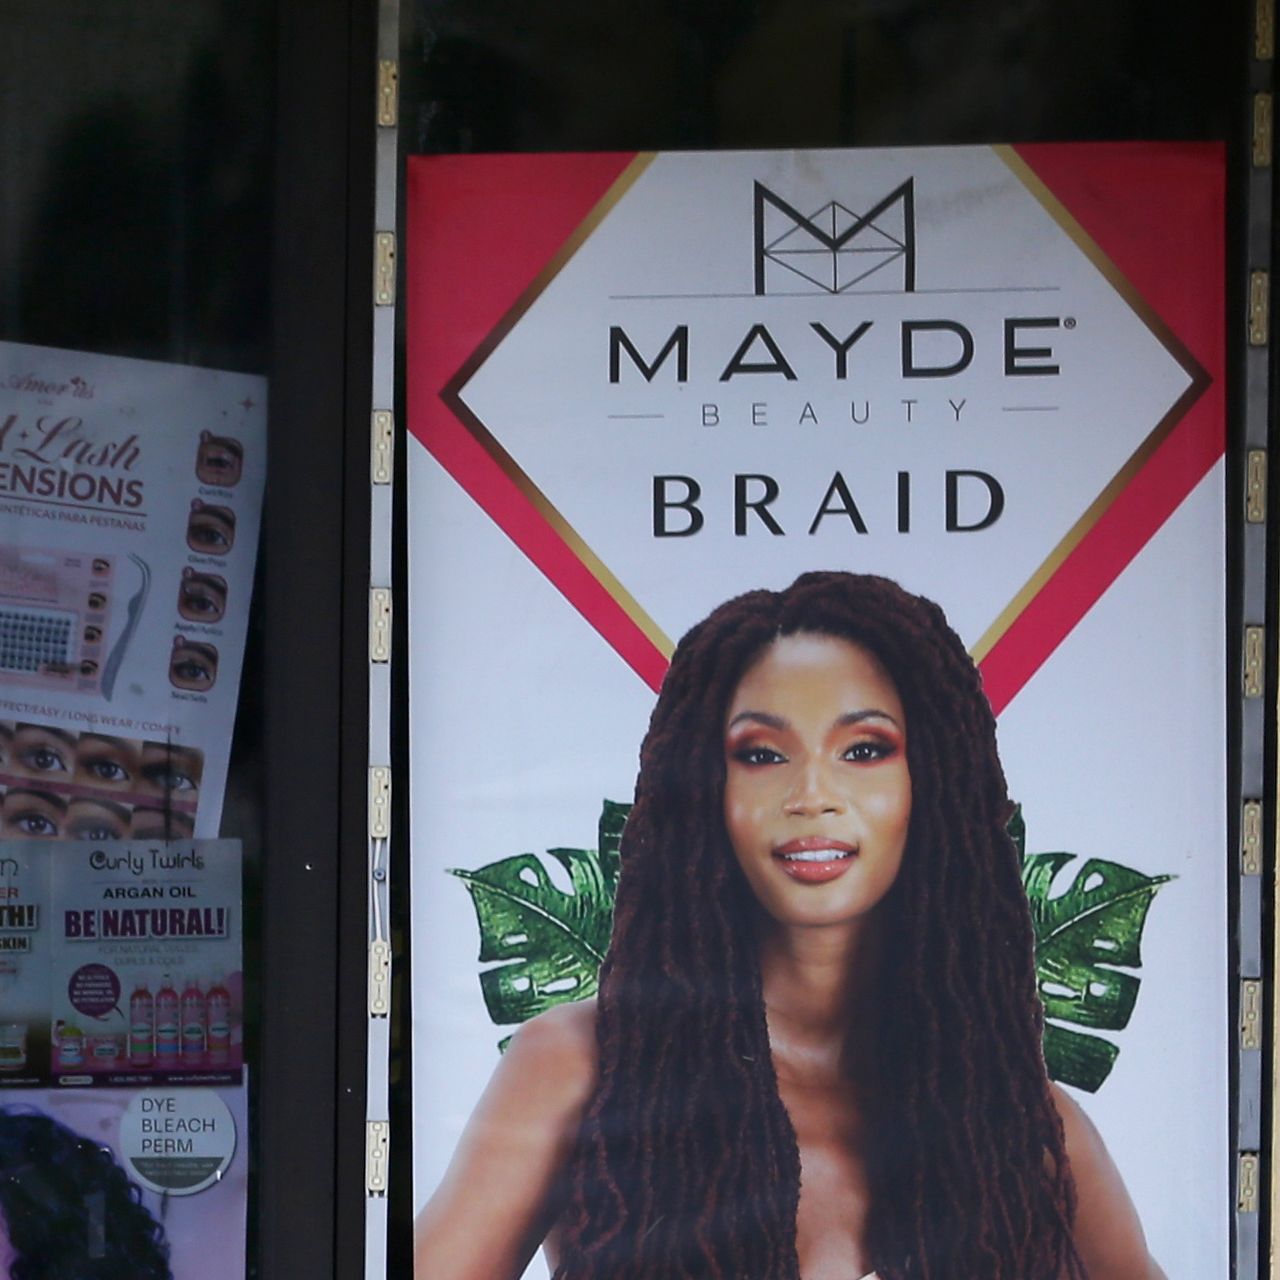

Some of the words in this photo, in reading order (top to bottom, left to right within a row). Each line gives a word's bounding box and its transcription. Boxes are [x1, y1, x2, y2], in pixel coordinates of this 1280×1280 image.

[608, 316, 1062, 386] MAYDE
[701, 398, 968, 427] BEAUTY
[12, 414, 143, 473] Lash
[652, 468, 1006, 537] BRAID
[89, 850, 144, 875] Curly
[151, 848, 205, 871] Twirls
[103, 886, 164, 899] ARGAN
[169, 885, 197, 899] OIL
[64, 910, 97, 938] BE
[102, 907, 226, 938] NATURAL!
[141, 1097, 177, 1113] DYE
[141, 1118, 216, 1133] BLEACH
[141, 1138, 194, 1154] PERM
